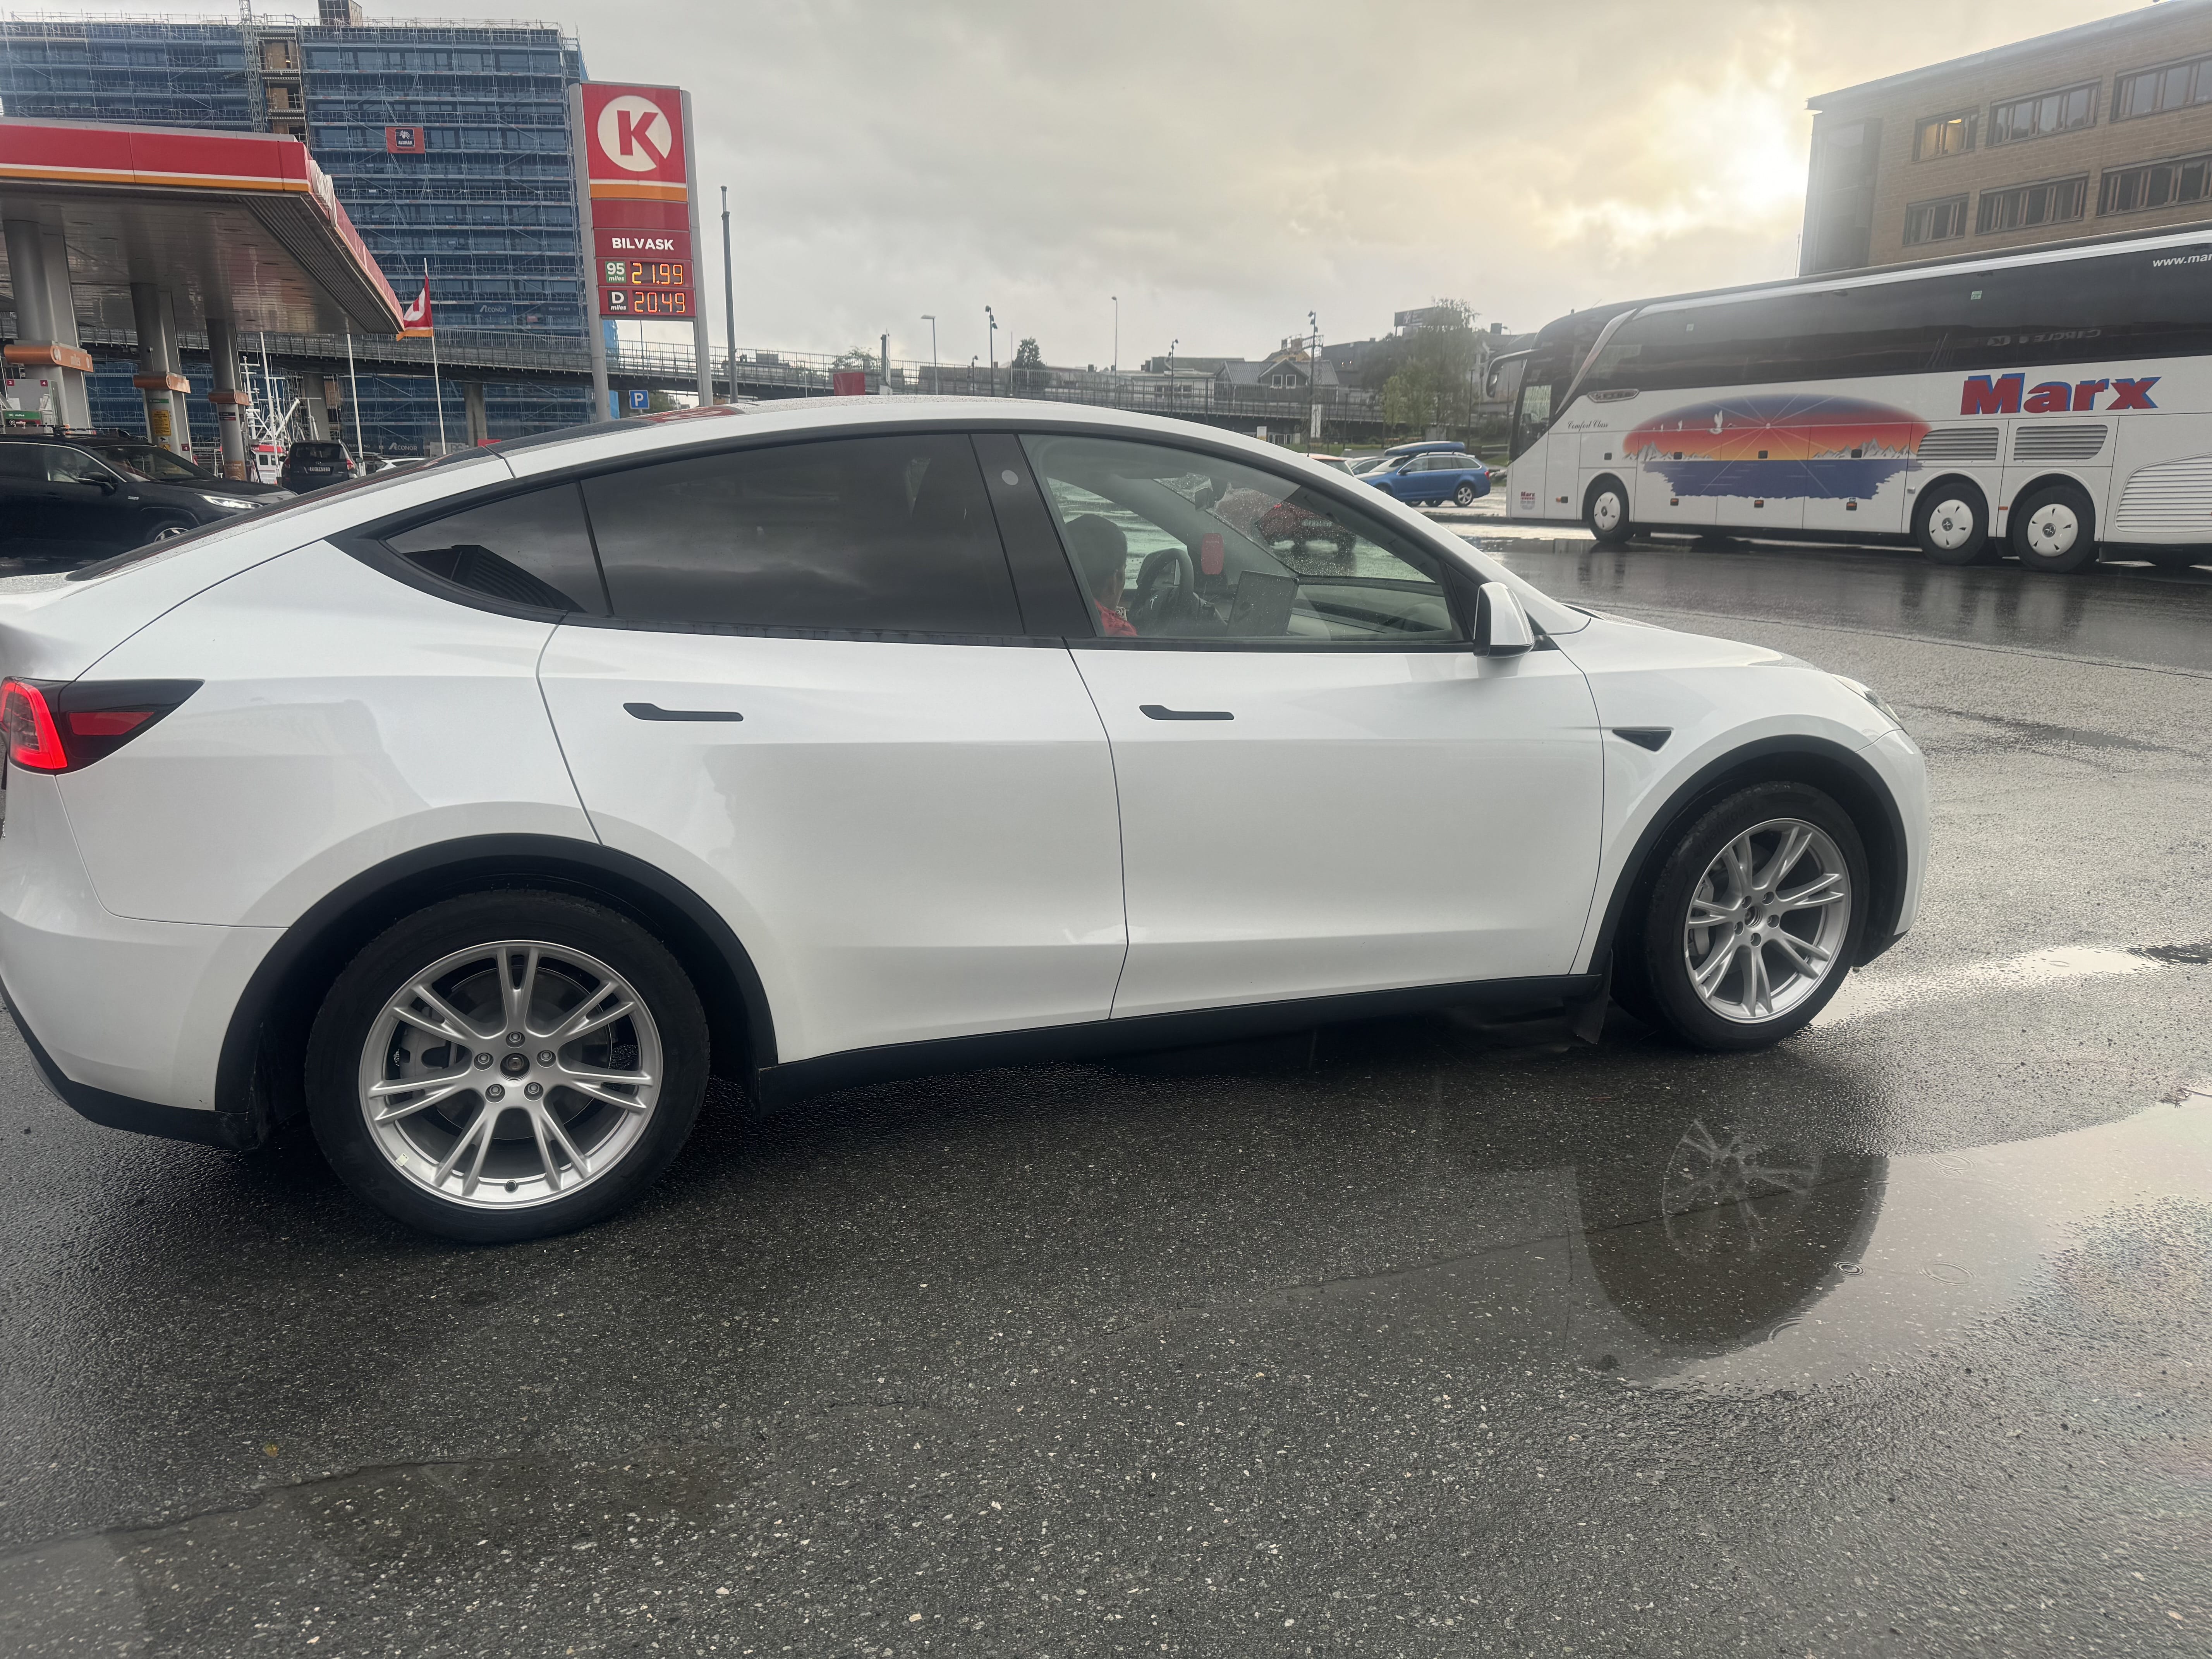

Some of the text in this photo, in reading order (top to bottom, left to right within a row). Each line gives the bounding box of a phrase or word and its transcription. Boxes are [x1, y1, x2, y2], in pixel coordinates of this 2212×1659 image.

[615, 108, 667, 170] K
[612, 237, 674, 251] BILVASK
[606, 262, 683, 285] 95 21.99
[611, 292, 685, 313] D 20.49
[634, 392, 644, 407] P
[1960, 373, 2162, 416] Marx
